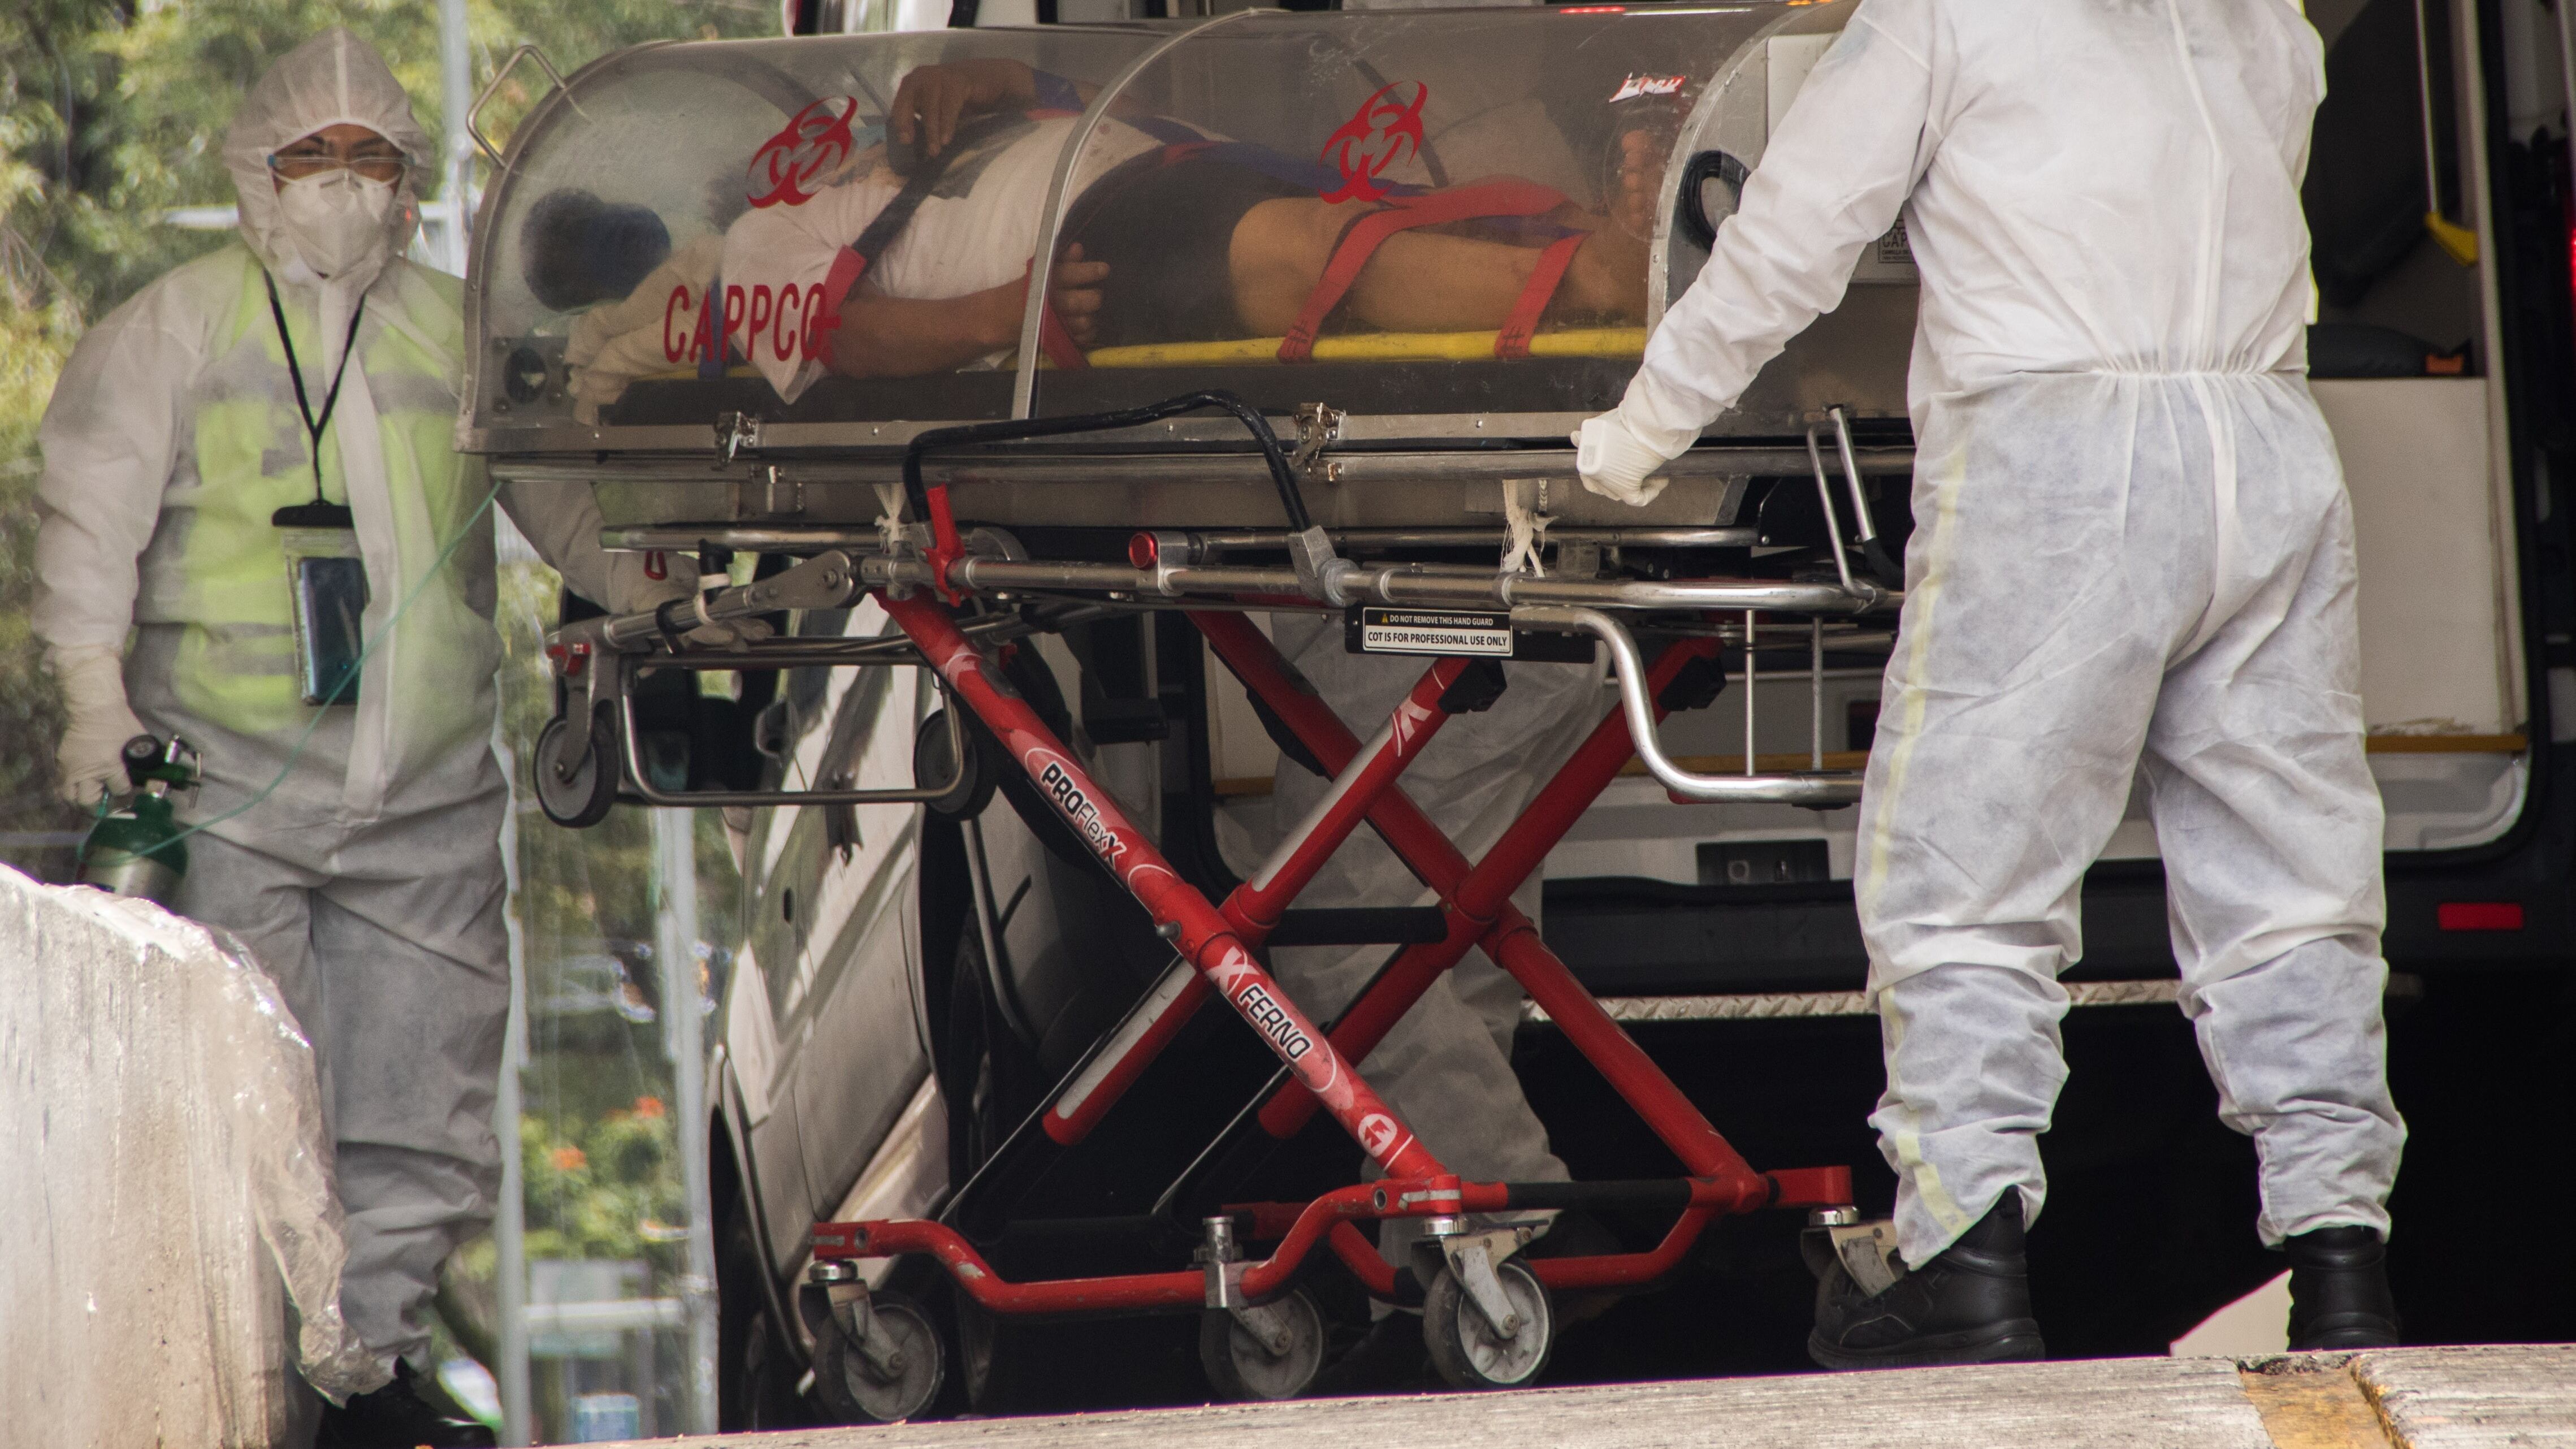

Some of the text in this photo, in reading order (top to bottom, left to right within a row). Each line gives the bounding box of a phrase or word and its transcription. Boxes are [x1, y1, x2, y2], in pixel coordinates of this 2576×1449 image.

[1414, 616, 1439, 624] REMOVE
[1439, 616, 1453, 625] THIS
[1368, 631, 1507, 646] COT IS FOR PROFESSIONAL USE ONLY
[1238, 983, 1314, 1062] FERNO
